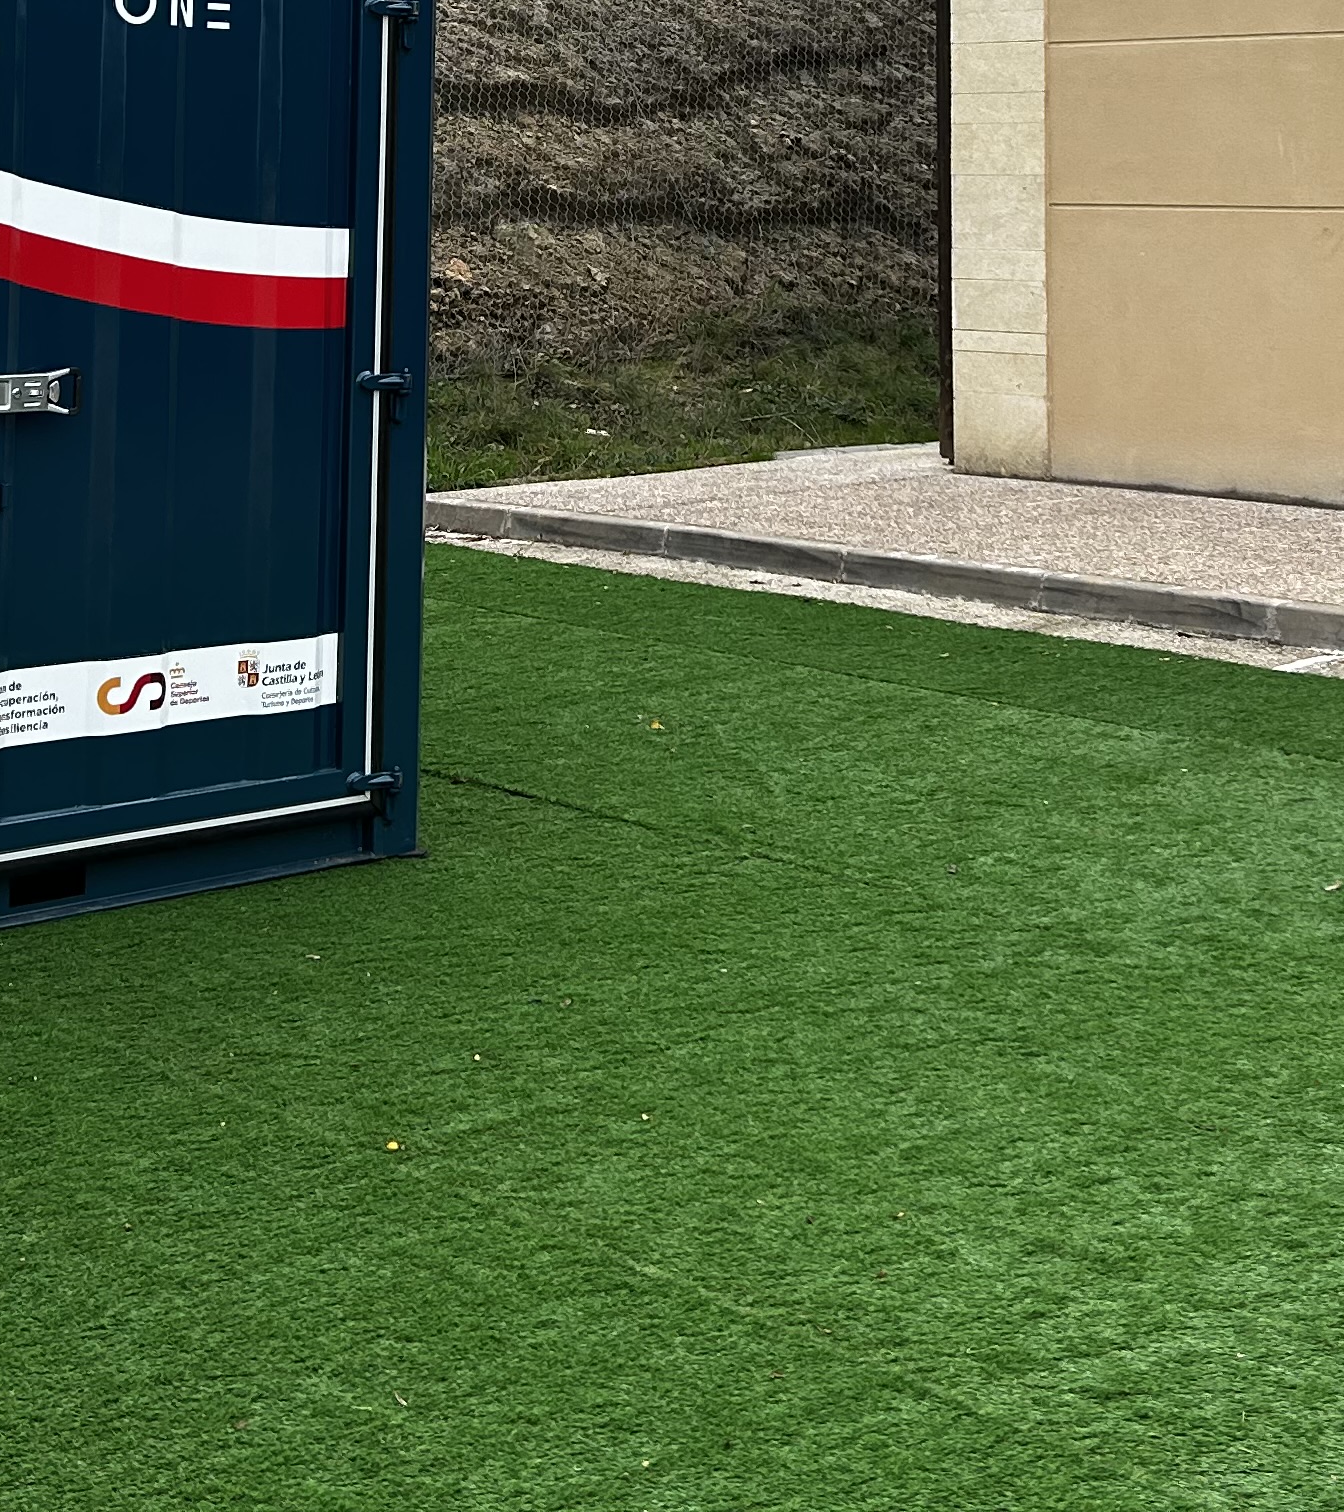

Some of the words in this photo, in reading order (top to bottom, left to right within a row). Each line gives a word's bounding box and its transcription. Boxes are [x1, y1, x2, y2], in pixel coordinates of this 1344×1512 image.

[262, 662, 291, 674] Junta
[294, 660, 306, 670] de
[9, 680, 22, 692] de
[262, 674, 298, 686] Castilla
[299, 675, 306, 685] y
